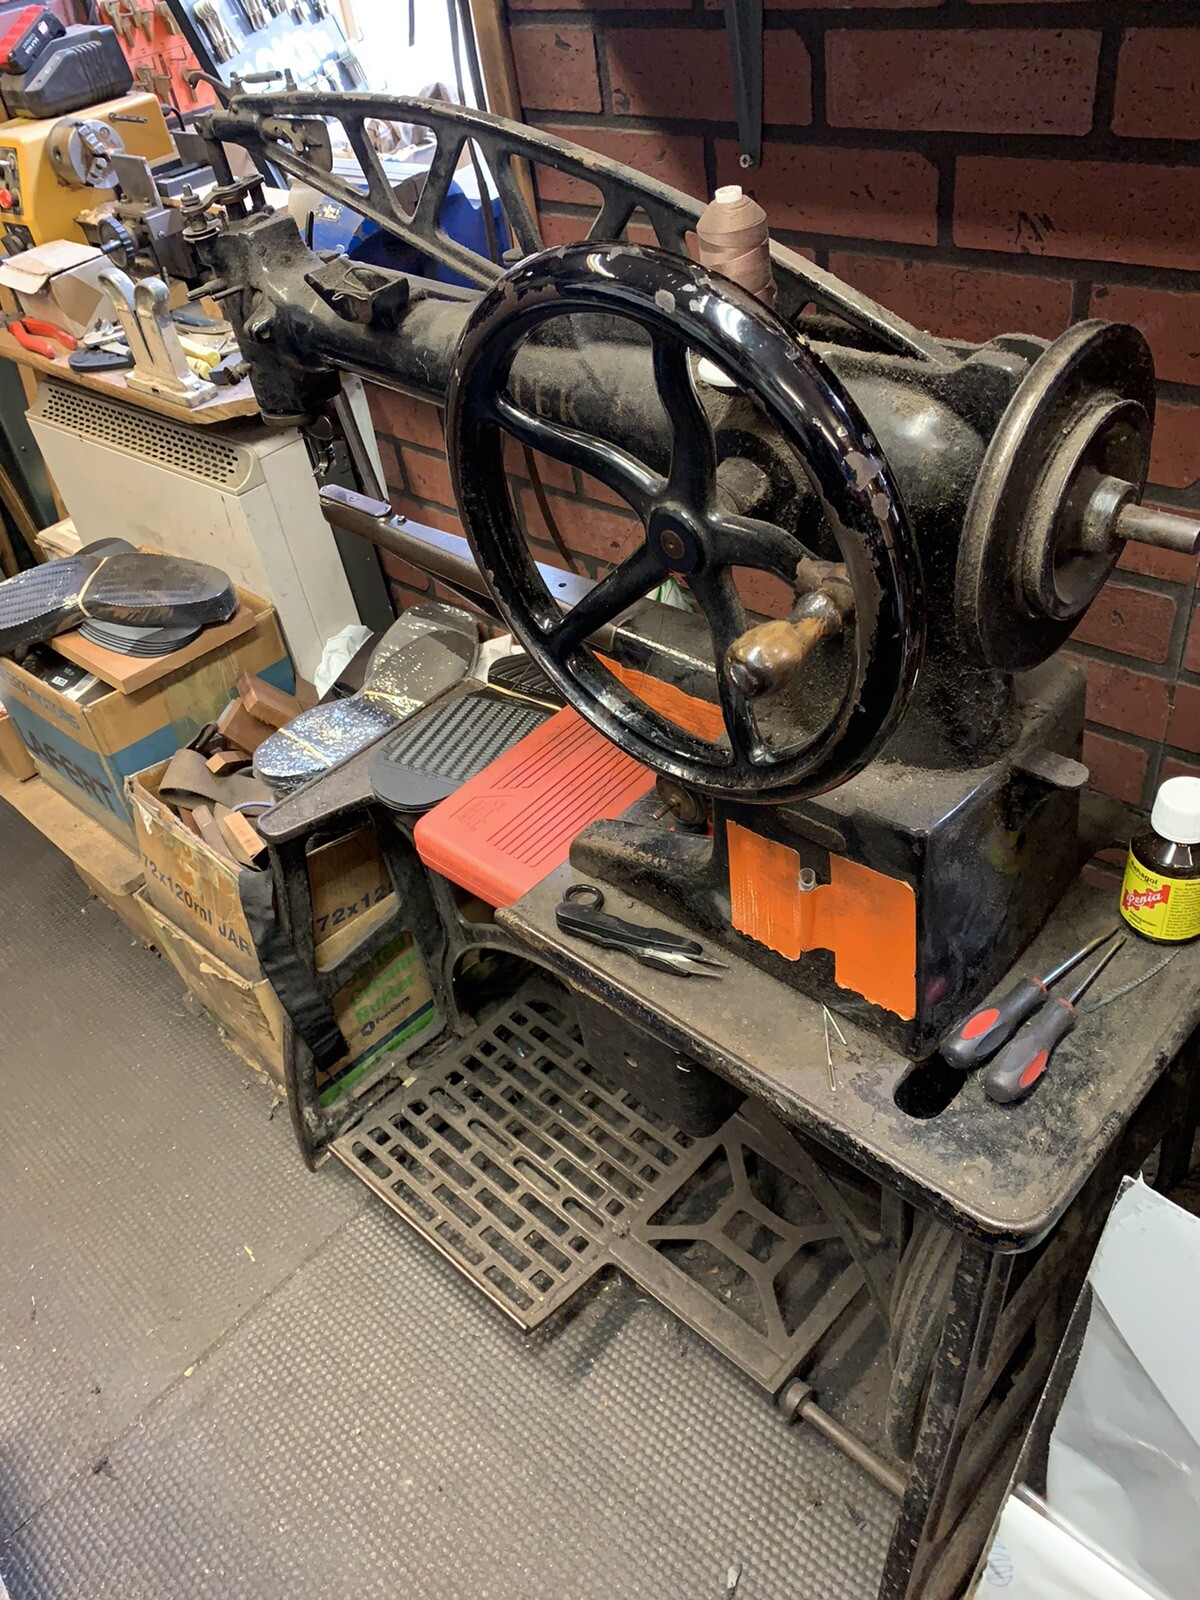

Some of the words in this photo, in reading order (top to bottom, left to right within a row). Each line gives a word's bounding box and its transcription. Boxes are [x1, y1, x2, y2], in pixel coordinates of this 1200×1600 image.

[12, 716, 116, 813] LAFERT
[142, 852, 213, 926] 72x120ml
[316, 884, 394, 933] 72x12
